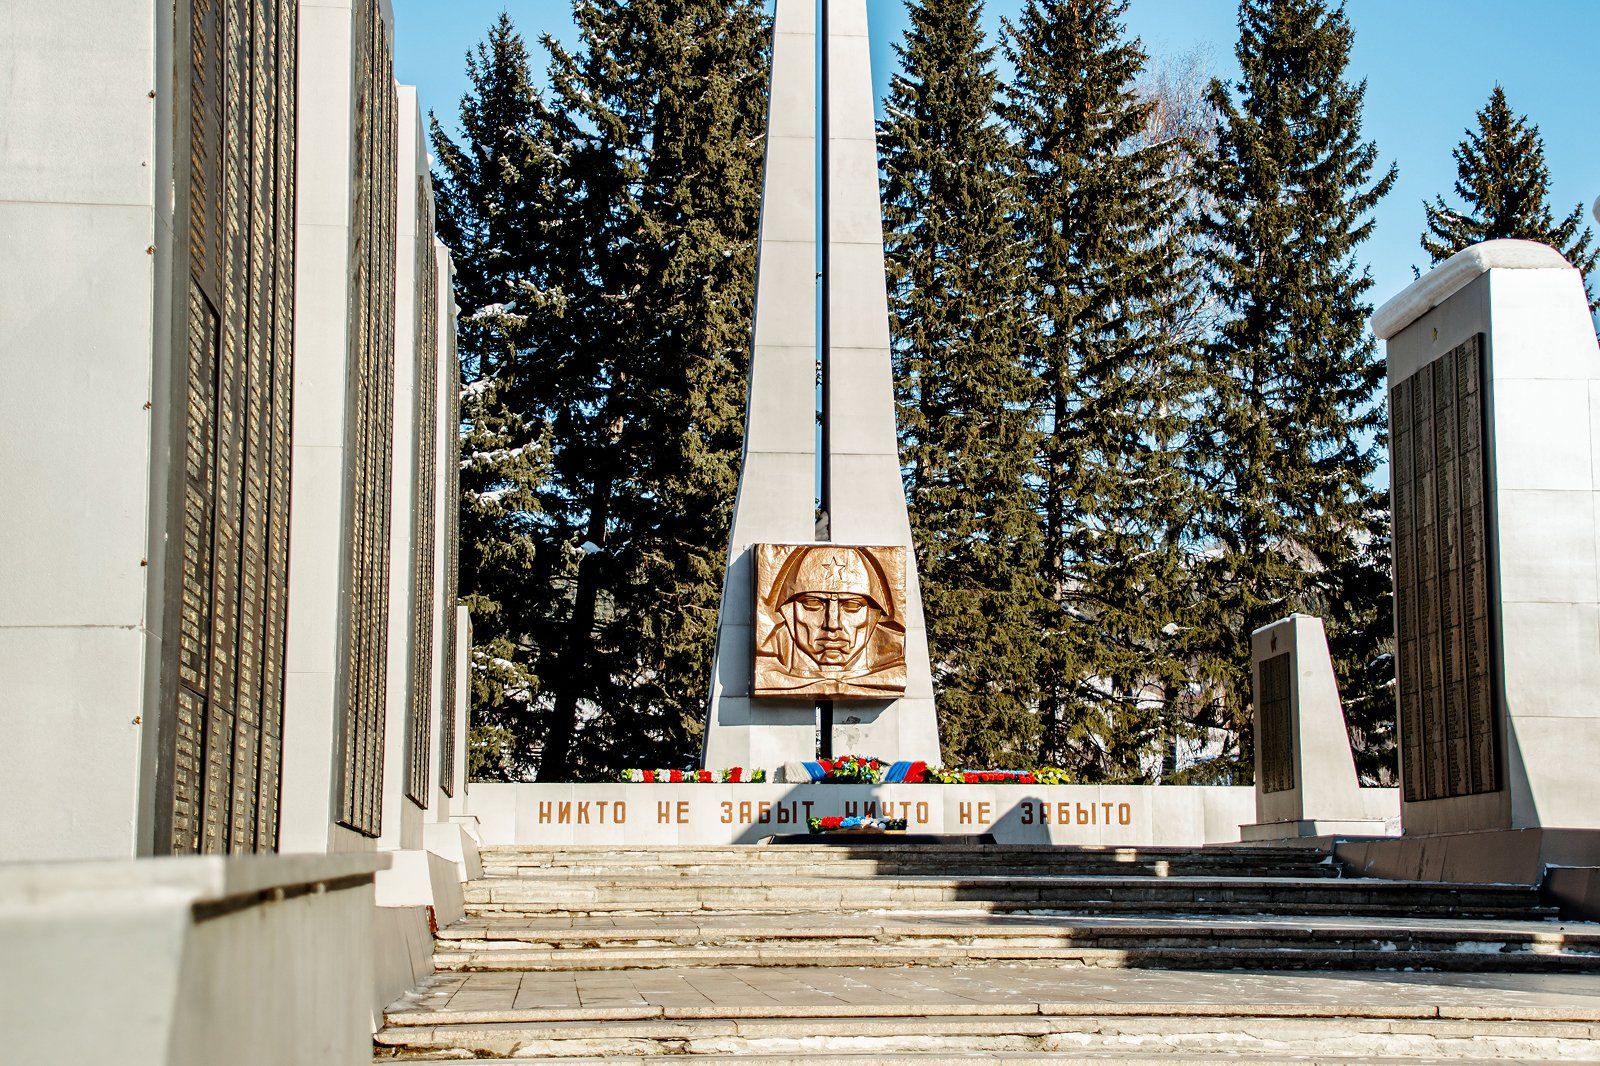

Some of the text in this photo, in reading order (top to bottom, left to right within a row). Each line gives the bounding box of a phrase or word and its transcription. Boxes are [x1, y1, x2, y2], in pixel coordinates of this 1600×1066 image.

[538, 801, 1131, 825] НИКТО НЕ ЗАБЫТ НИЧТО НЕ ЗАБЫТО
